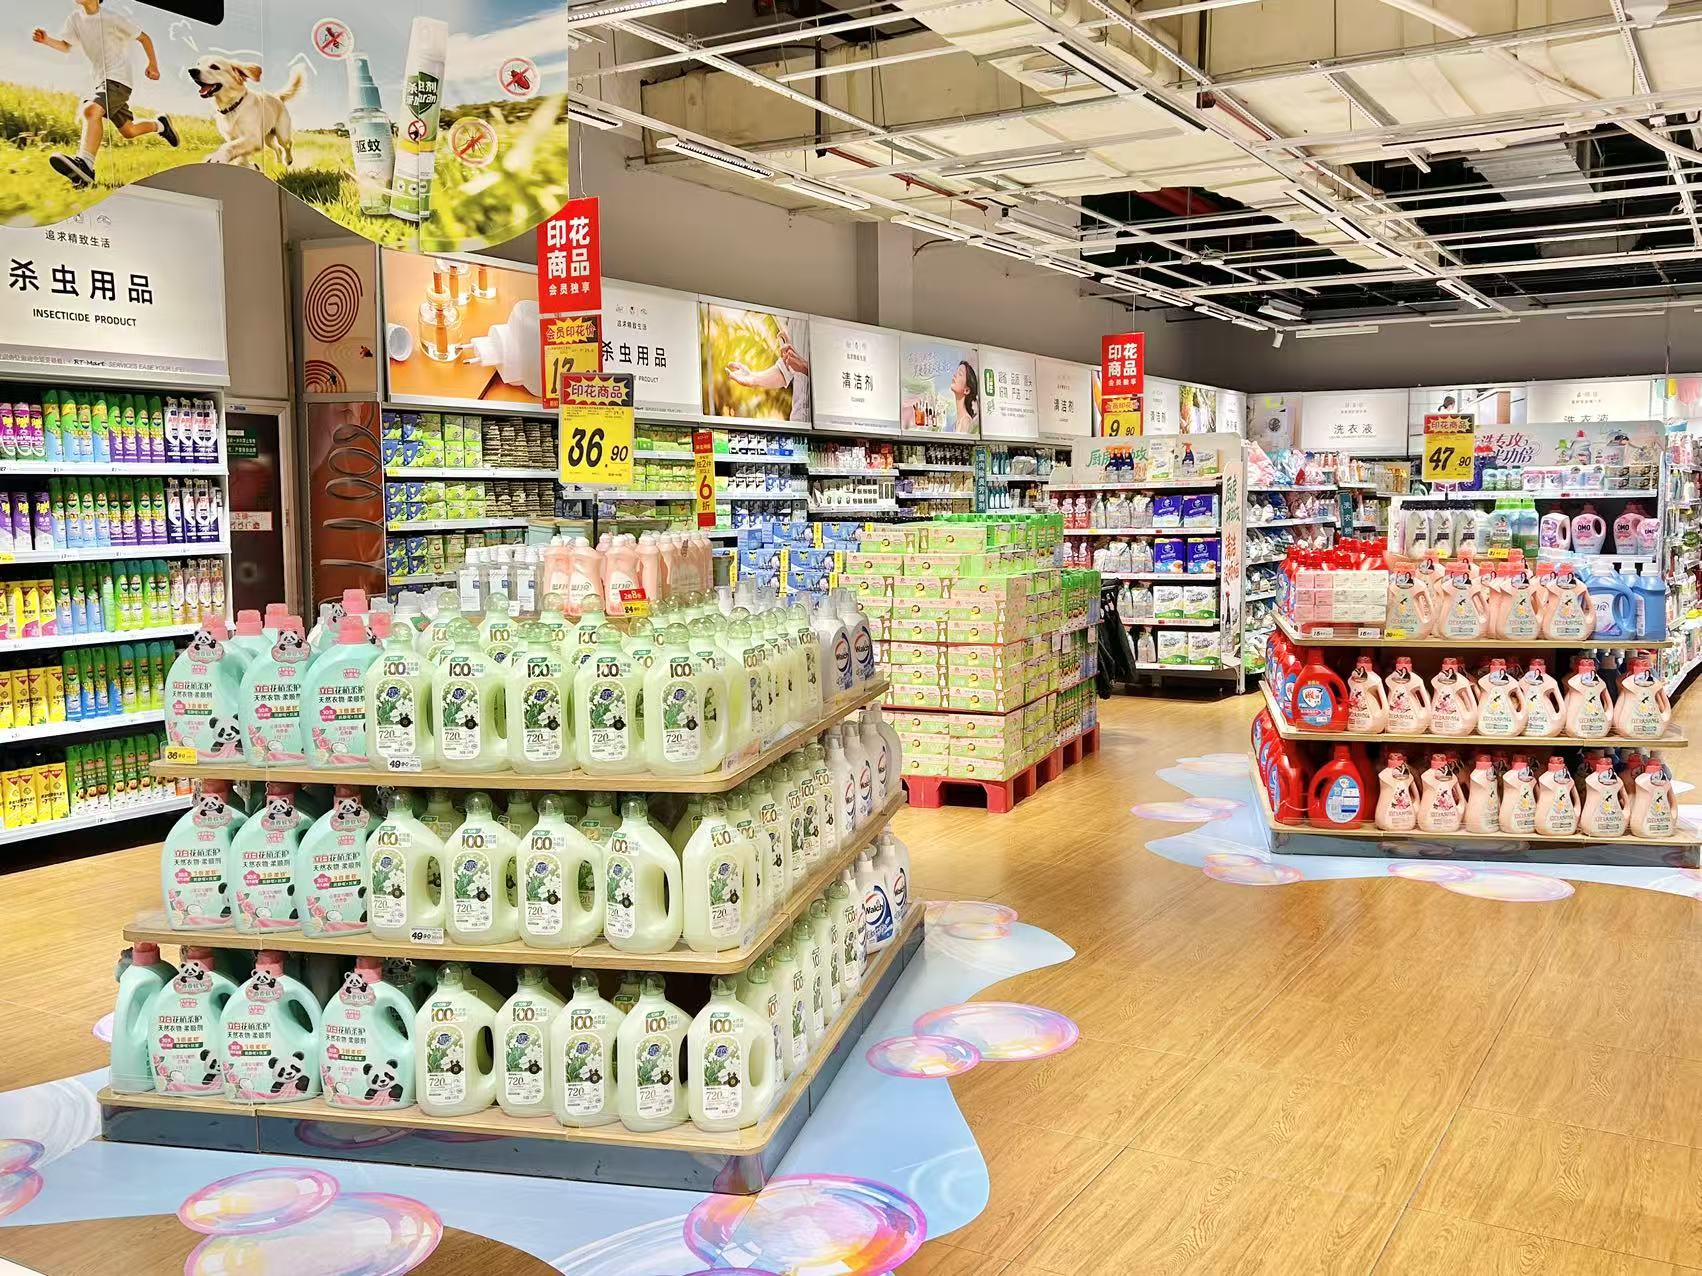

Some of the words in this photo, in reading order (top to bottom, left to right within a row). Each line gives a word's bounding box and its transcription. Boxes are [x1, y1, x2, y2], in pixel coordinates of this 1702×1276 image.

[355, 139, 382, 153] 驱蚊
[45, 229, 111, 248] 追求精致生活
[547, 216, 590, 248] 印花
[547, 248, 590, 279] 商品
[9, 258, 153, 305] 杀虫用品
[549, 282, 590, 296] 会员独享
[33, 308, 90, 323] INSECTICIDE
[95, 315, 136, 327] PRODUCT
[546, 323, 596, 340] 会员印花价
[602, 341, 666, 368] 杀虫用品
[1108, 343, 1137, 360] 印花
[1108, 360, 1137, 377] 商品
[842, 372, 873, 391] 清洁剂
[572, 384, 622, 399] 印花商品
[1109, 419, 1120, 437] 9
[1334, 423, 1373, 435] 洗衣液
[1431, 421, 1466, 429] 印花商品
[699, 475, 712, 500] 6
[490, 630, 510, 642] 100
[384, 662, 406, 676] 100
[449, 663, 471, 677] 100
[527, 663, 550, 678] 100
[596, 663, 620, 678] 100
[670, 663, 692, 678] 100
[379, 730, 394, 739] 720
[445, 732, 460, 740] 720
[527, 734, 543, 743] 720
[592, 734, 609, 743] 720
[666, 734, 682, 743] 720
[377, 832, 398, 846] 100
[461, 834, 484, 848] 100
[531, 837, 552, 850] 100
[611, 838, 627, 852] 100
[713, 831, 731, 847] 100
[865, 904, 884, 915] Walch
[411, 932, 423, 940] 49
[431, 1008, 453, 1022] 100
[513, 1007, 535, 1022] 100
[570, 1015, 593, 1030] 100
[645, 1017, 667, 1033] 100
[709, 1018, 732, 1033] 100
[429, 1077, 446, 1087] 720
[508, 1077, 524, 1086] 720
[568, 1087, 584, 1097] 720
[639, 1089, 656, 1099] 720
[706, 1090, 722, 1100] 720
